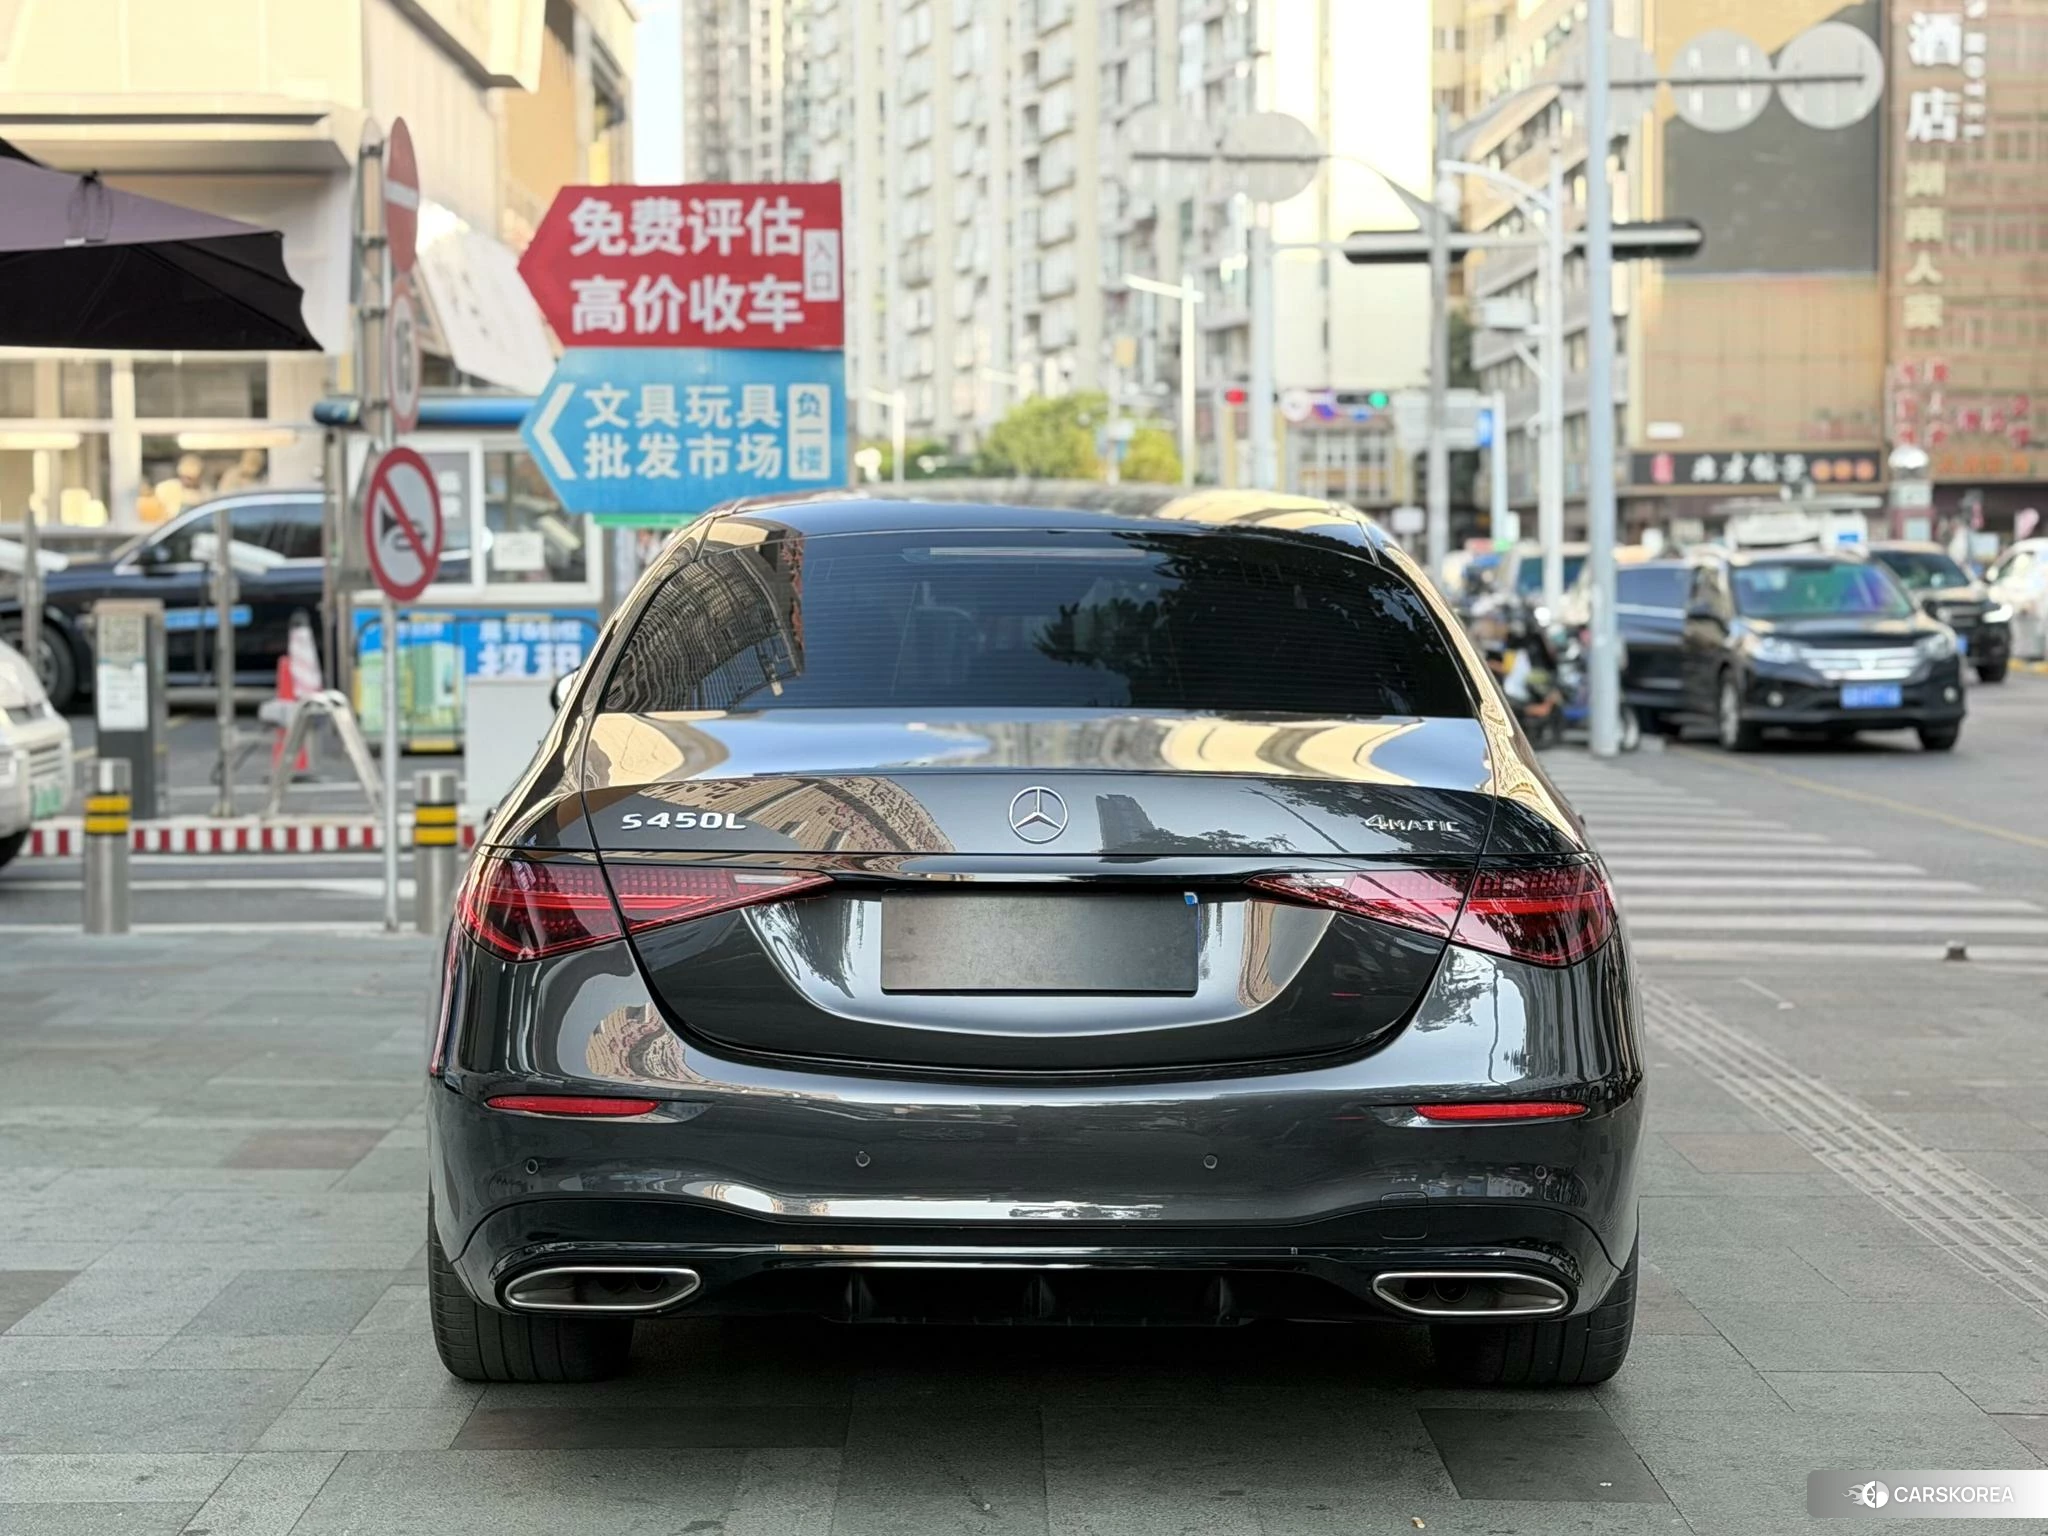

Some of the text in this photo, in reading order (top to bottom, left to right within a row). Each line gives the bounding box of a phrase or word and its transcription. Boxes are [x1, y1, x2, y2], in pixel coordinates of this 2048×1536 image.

[568, 196, 804, 256] 免费评估
[569, 273, 804, 334] 高价收车
[583, 381, 782, 430] 文具玩具
[583, 433, 783, 481] 批发市场
[620, 811, 748, 831] S450L
[1364, 814, 1462, 833] 4MATIC
